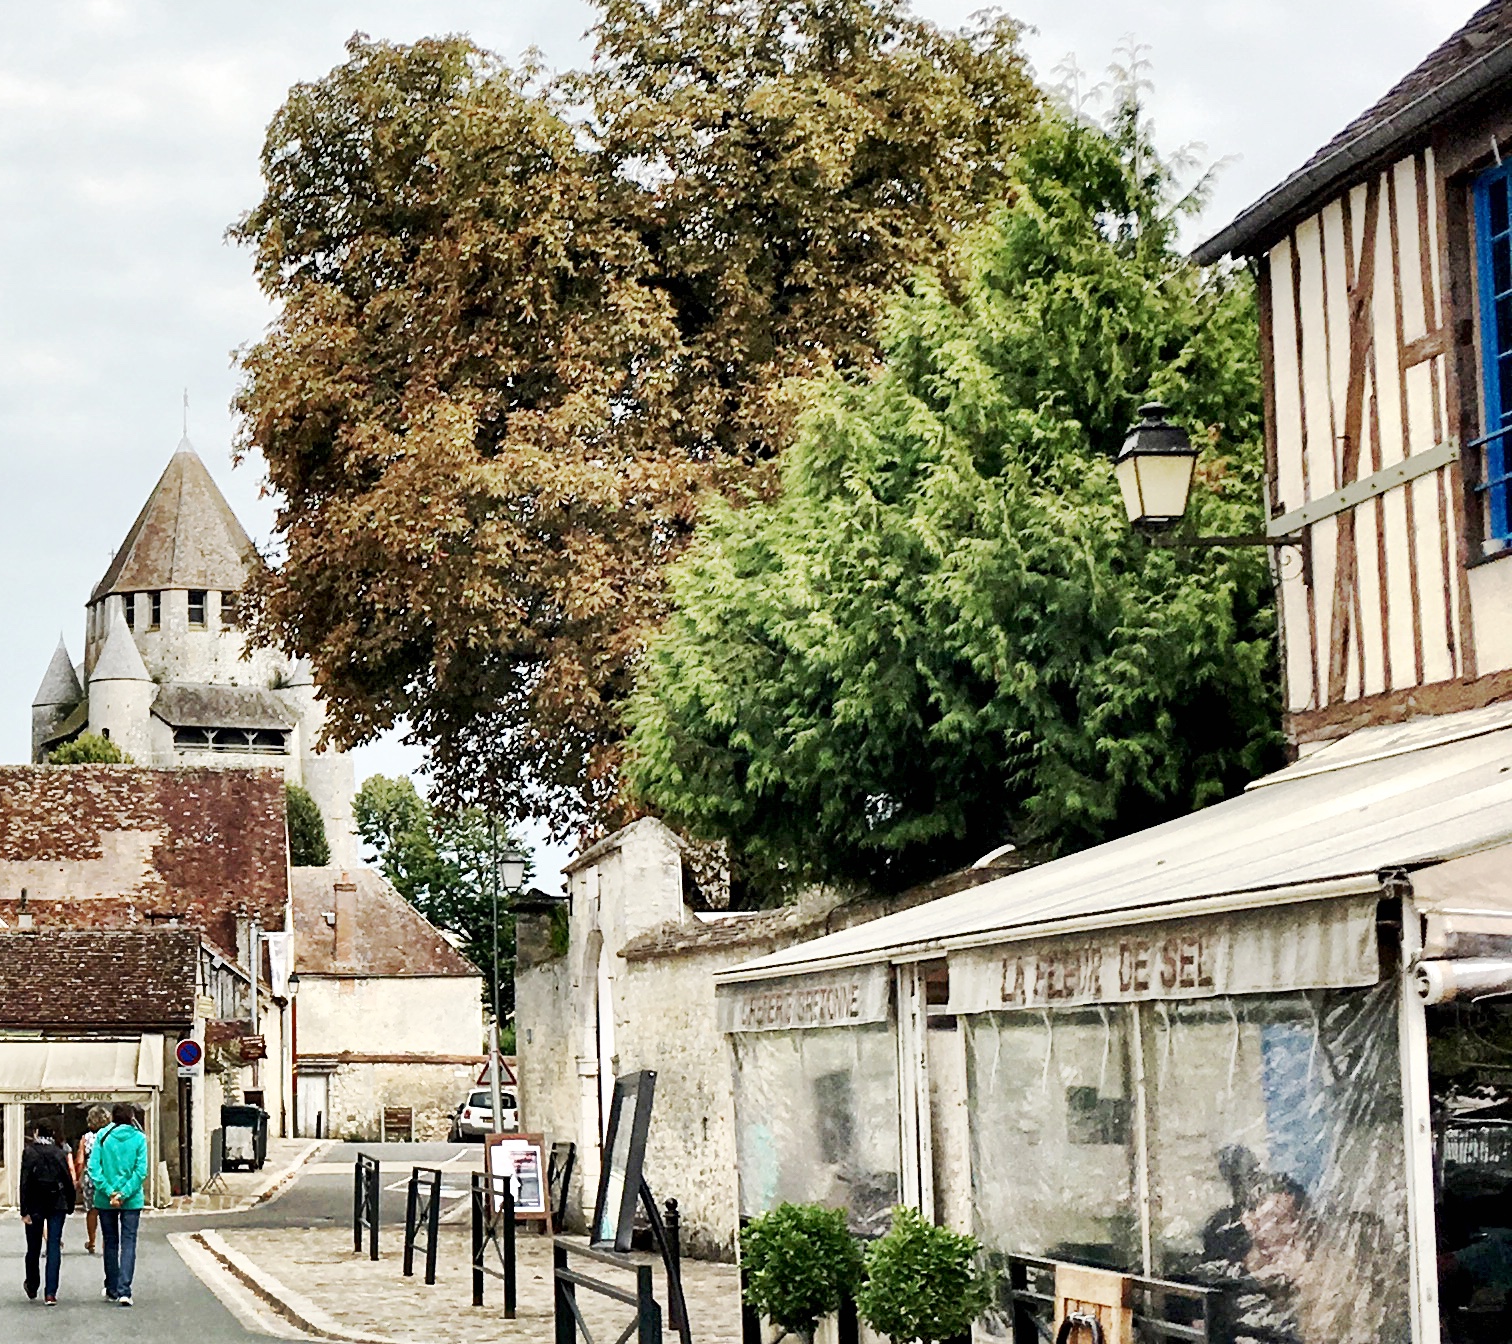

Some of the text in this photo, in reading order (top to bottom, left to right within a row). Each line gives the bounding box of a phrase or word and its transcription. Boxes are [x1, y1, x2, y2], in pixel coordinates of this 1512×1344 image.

[1001, 935, 1214, 1005] LA FLEUR DE SEL
[68, 1092, 113, 1101] GAUFRES
